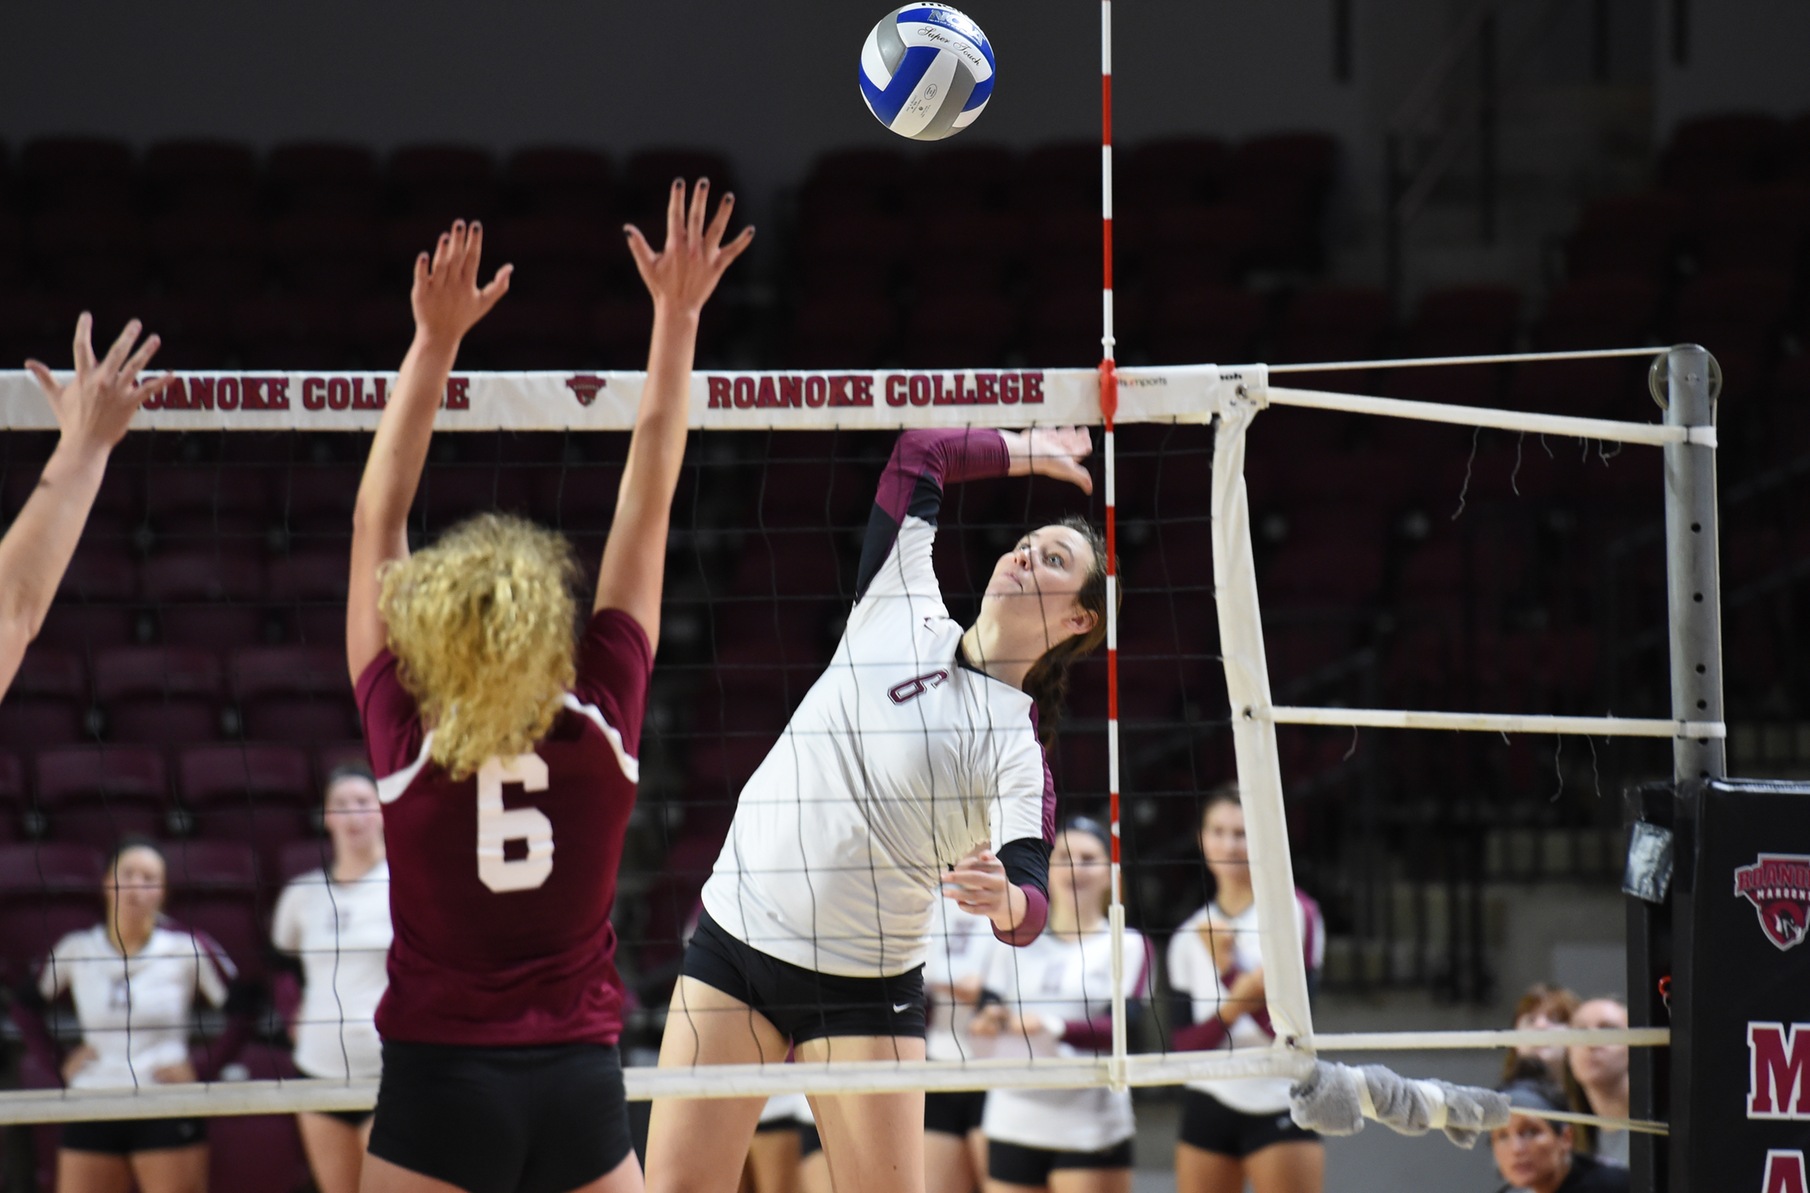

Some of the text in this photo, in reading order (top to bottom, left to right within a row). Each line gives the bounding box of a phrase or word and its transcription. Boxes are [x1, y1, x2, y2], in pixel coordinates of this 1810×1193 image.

[917, 26, 982, 66] Super Touch
[132, 377, 469, 410] OANOKE COLLE
[707, 372, 1044, 408] ROANOKE COLLEGE
[887, 668, 949, 705] 6
[477, 751, 554, 893] 6
[1737, 863, 1810, 892] ROANO
[1757, 888, 1810, 900] MAROON
